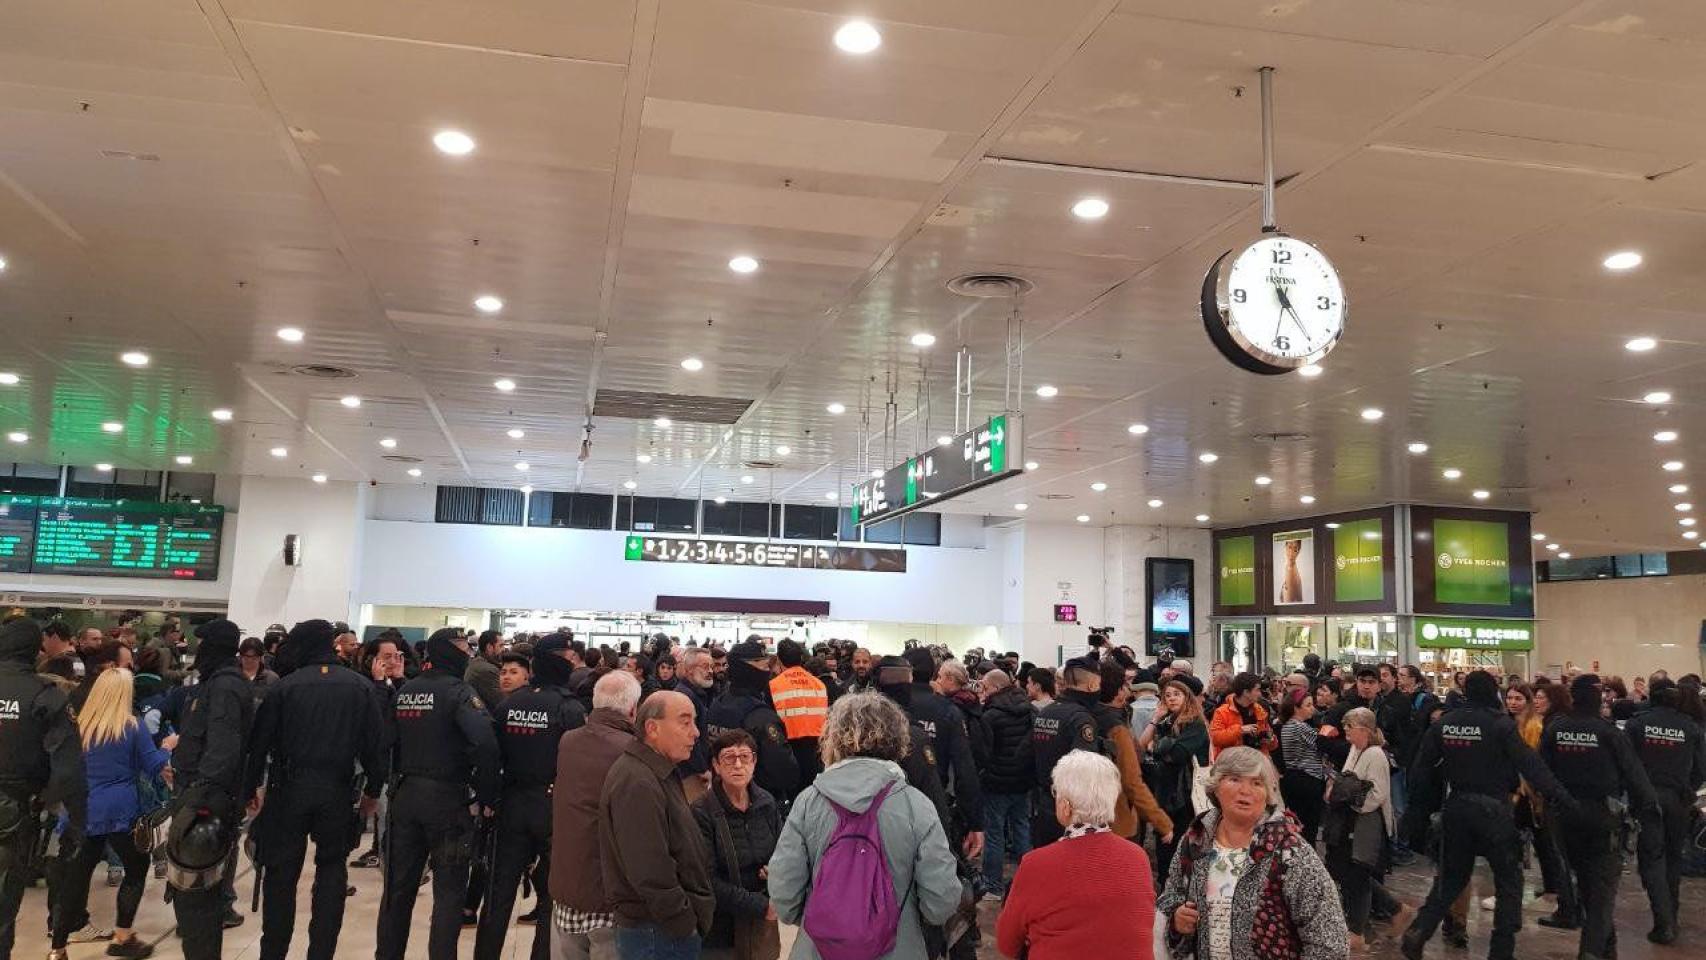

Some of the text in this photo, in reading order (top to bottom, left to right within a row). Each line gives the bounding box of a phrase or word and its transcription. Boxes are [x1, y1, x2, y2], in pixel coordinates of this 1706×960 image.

[1271, 250, 1292, 264] 12
[1233, 289, 1247, 303] 9
[1317, 296, 1330, 310] 3
[1276, 336, 1290, 350] 6
[1475, 559, 1506, 567] ROCHER
[1439, 627, 1530, 640] YVES ROCHER
[397, 693, 434, 704] POLICIA
[507, 709, 549, 723] POLICIA
[1034, 717, 1059, 729] POLICIA
[1442, 724, 1482, 735] POLICIA
[1556, 731, 1599, 742] POLICIA
[1645, 725, 1685, 738] POLICIA
